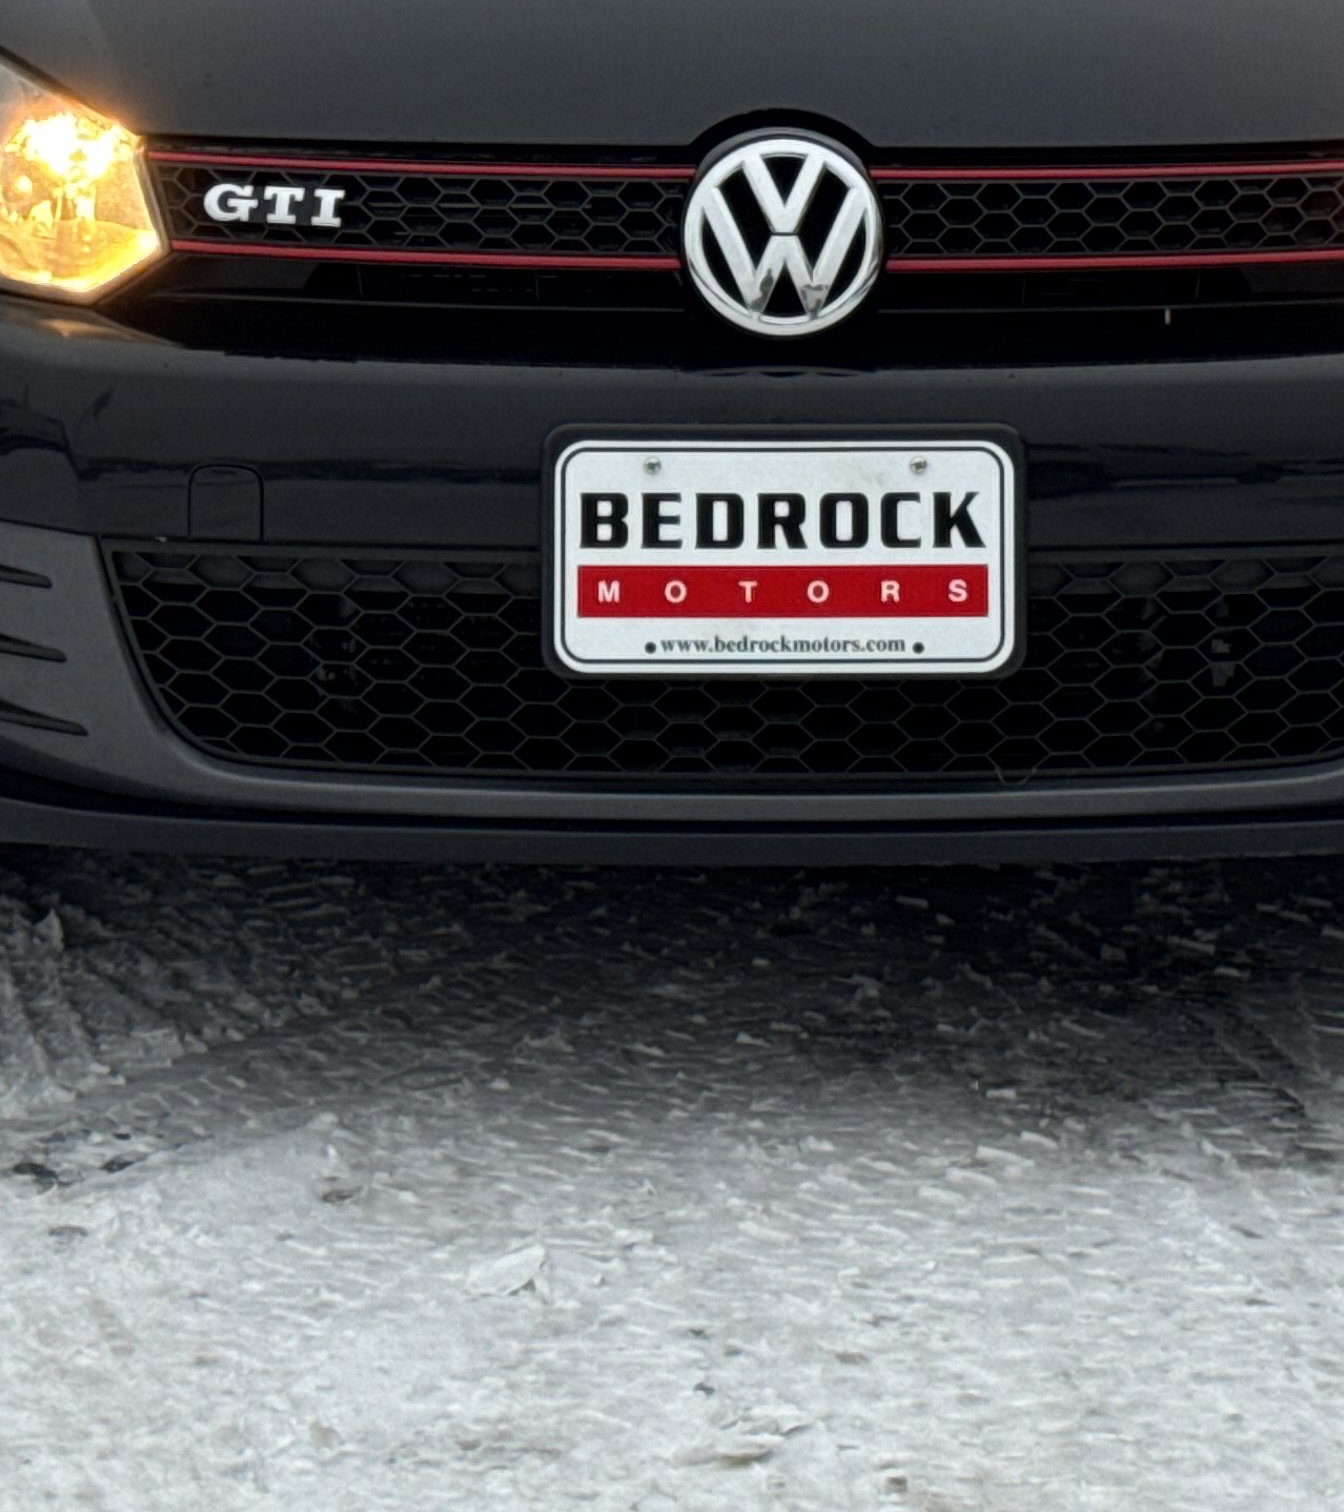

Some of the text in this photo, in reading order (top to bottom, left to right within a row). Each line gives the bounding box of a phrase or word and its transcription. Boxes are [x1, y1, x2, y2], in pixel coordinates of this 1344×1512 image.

[203, 183, 346, 228] GTI
[578, 491, 987, 549] BEDROCK
[597, 579, 969, 604] MOTORS
[659, 635, 906, 654] www.bedrockmotors.com
